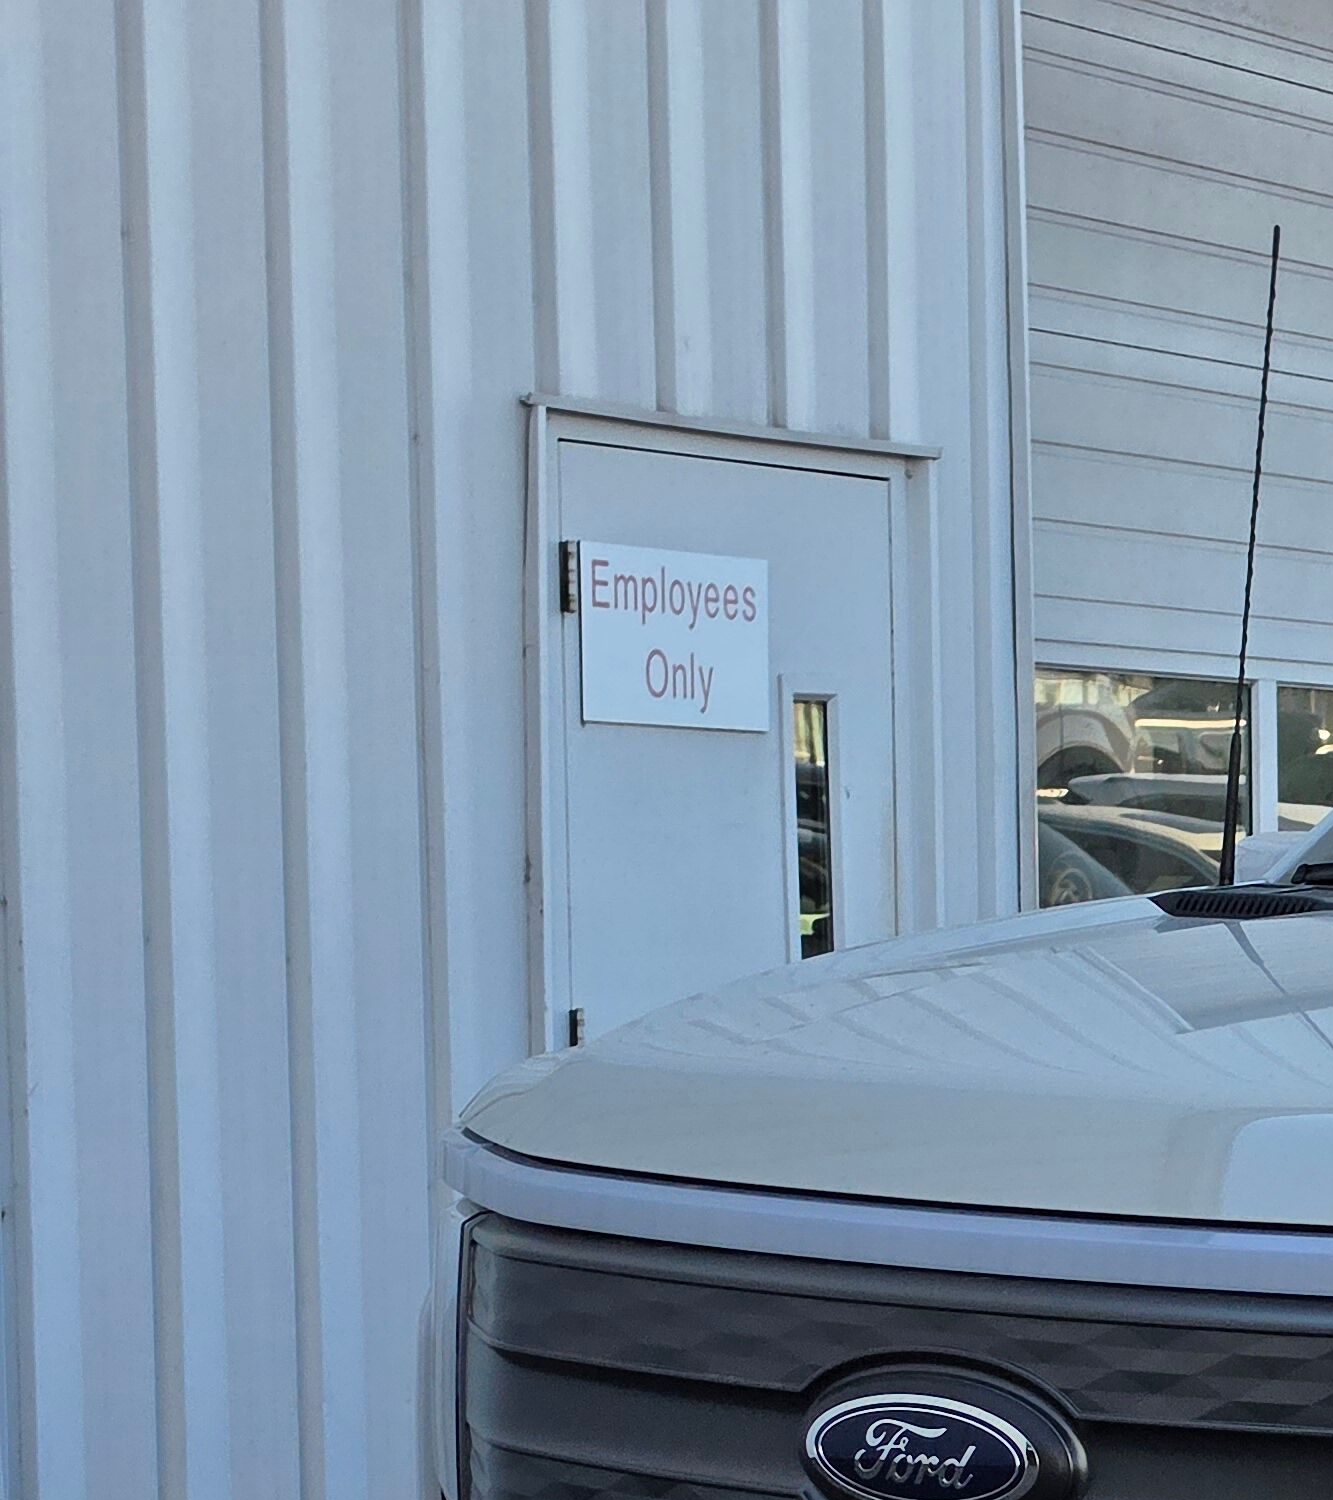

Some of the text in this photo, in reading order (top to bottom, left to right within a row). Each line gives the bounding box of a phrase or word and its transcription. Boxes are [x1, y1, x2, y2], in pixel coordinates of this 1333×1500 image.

[591, 559, 757, 630] Employees
[646, 648, 714, 714] Only
[854, 1418, 977, 1490] Ford
